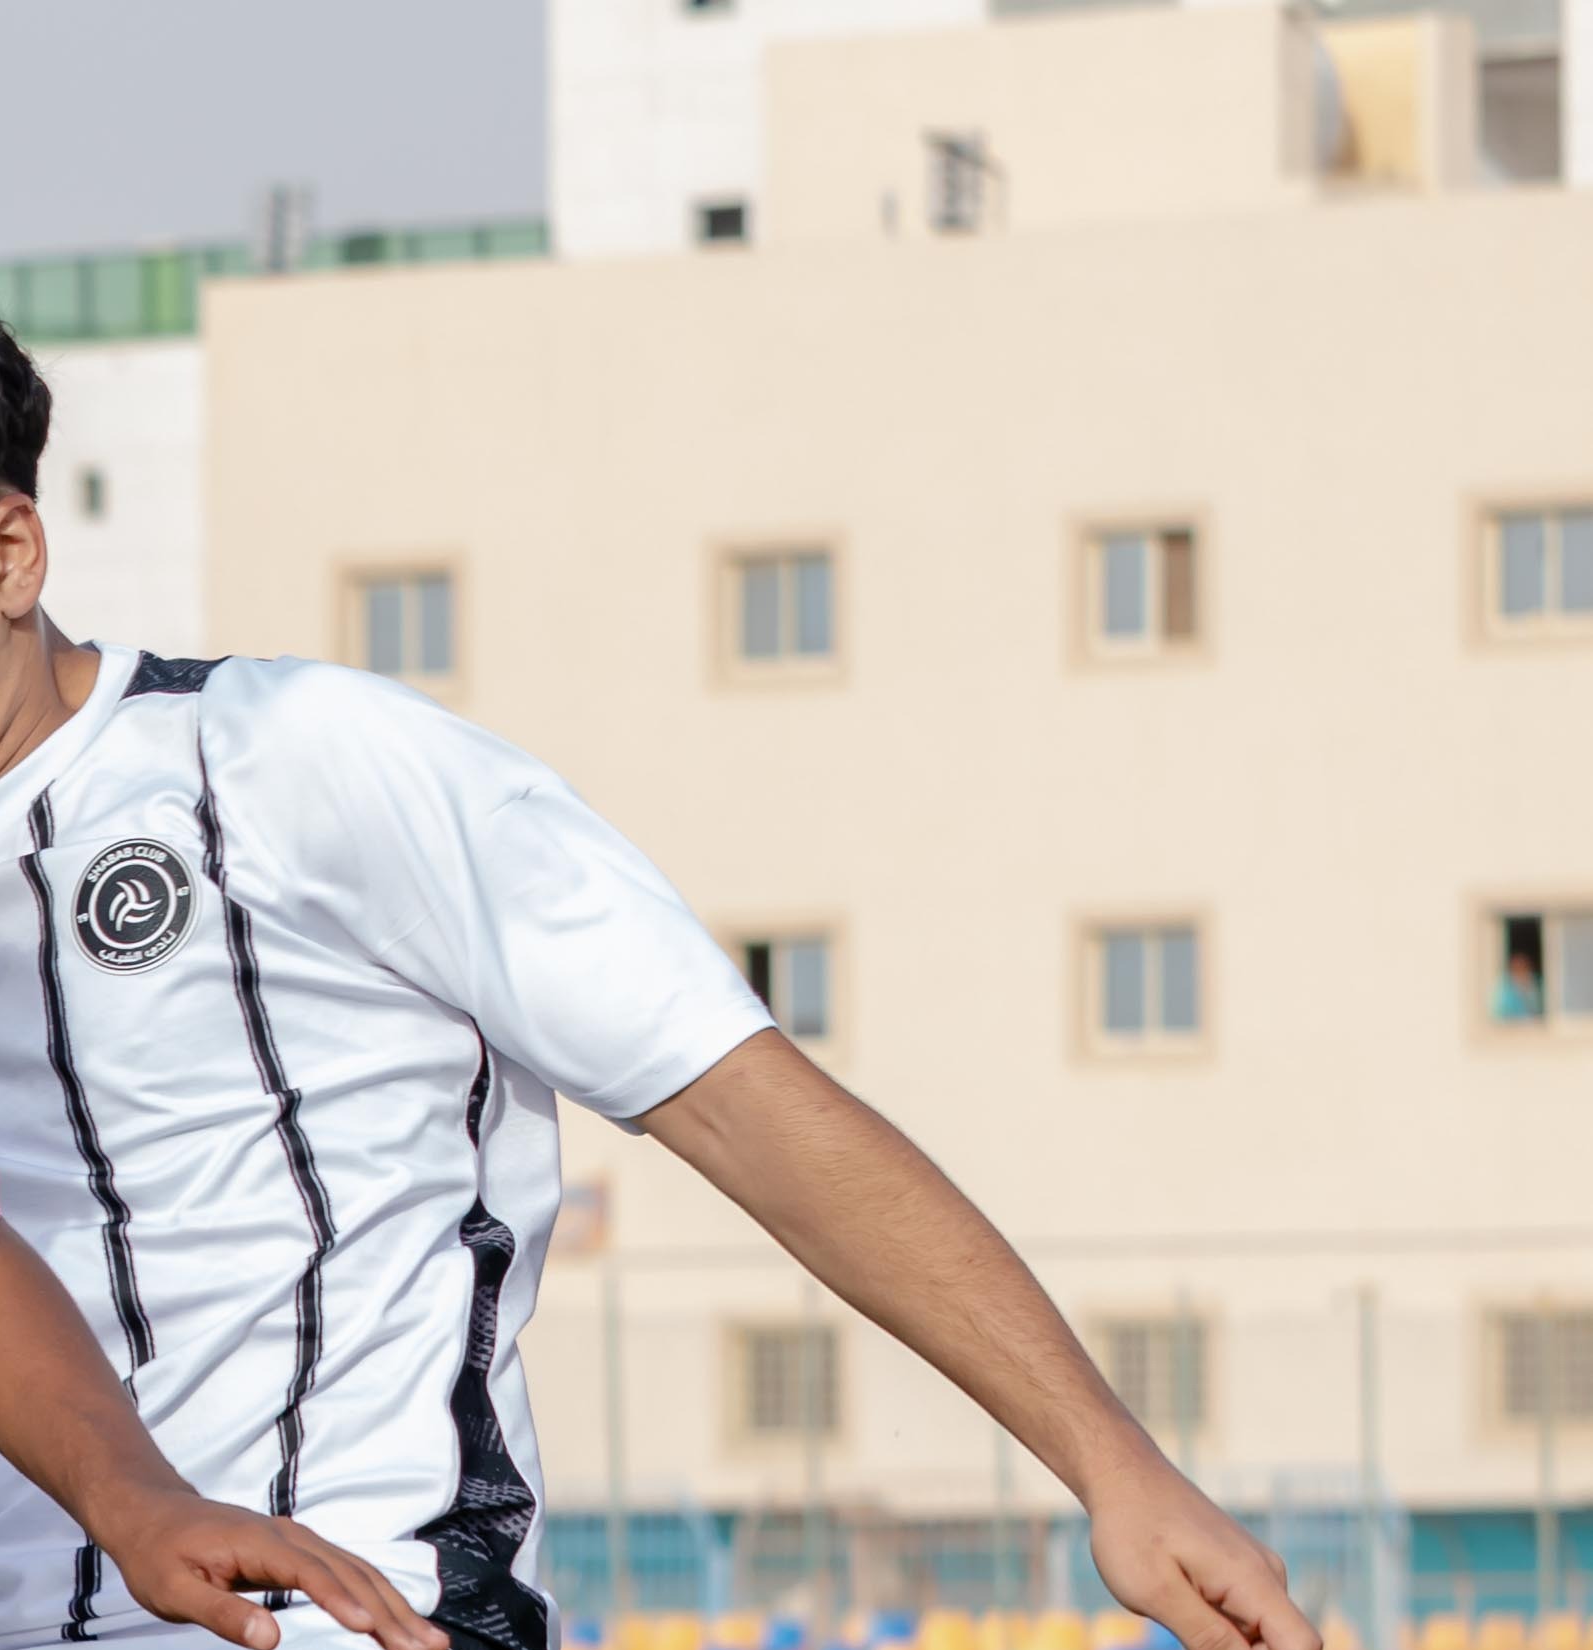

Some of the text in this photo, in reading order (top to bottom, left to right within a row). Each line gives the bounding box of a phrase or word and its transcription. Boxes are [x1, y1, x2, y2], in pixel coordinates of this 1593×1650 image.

[87, 846, 168, 883] SHABAB CLUB
[145, 931, 177, 958] نادي
